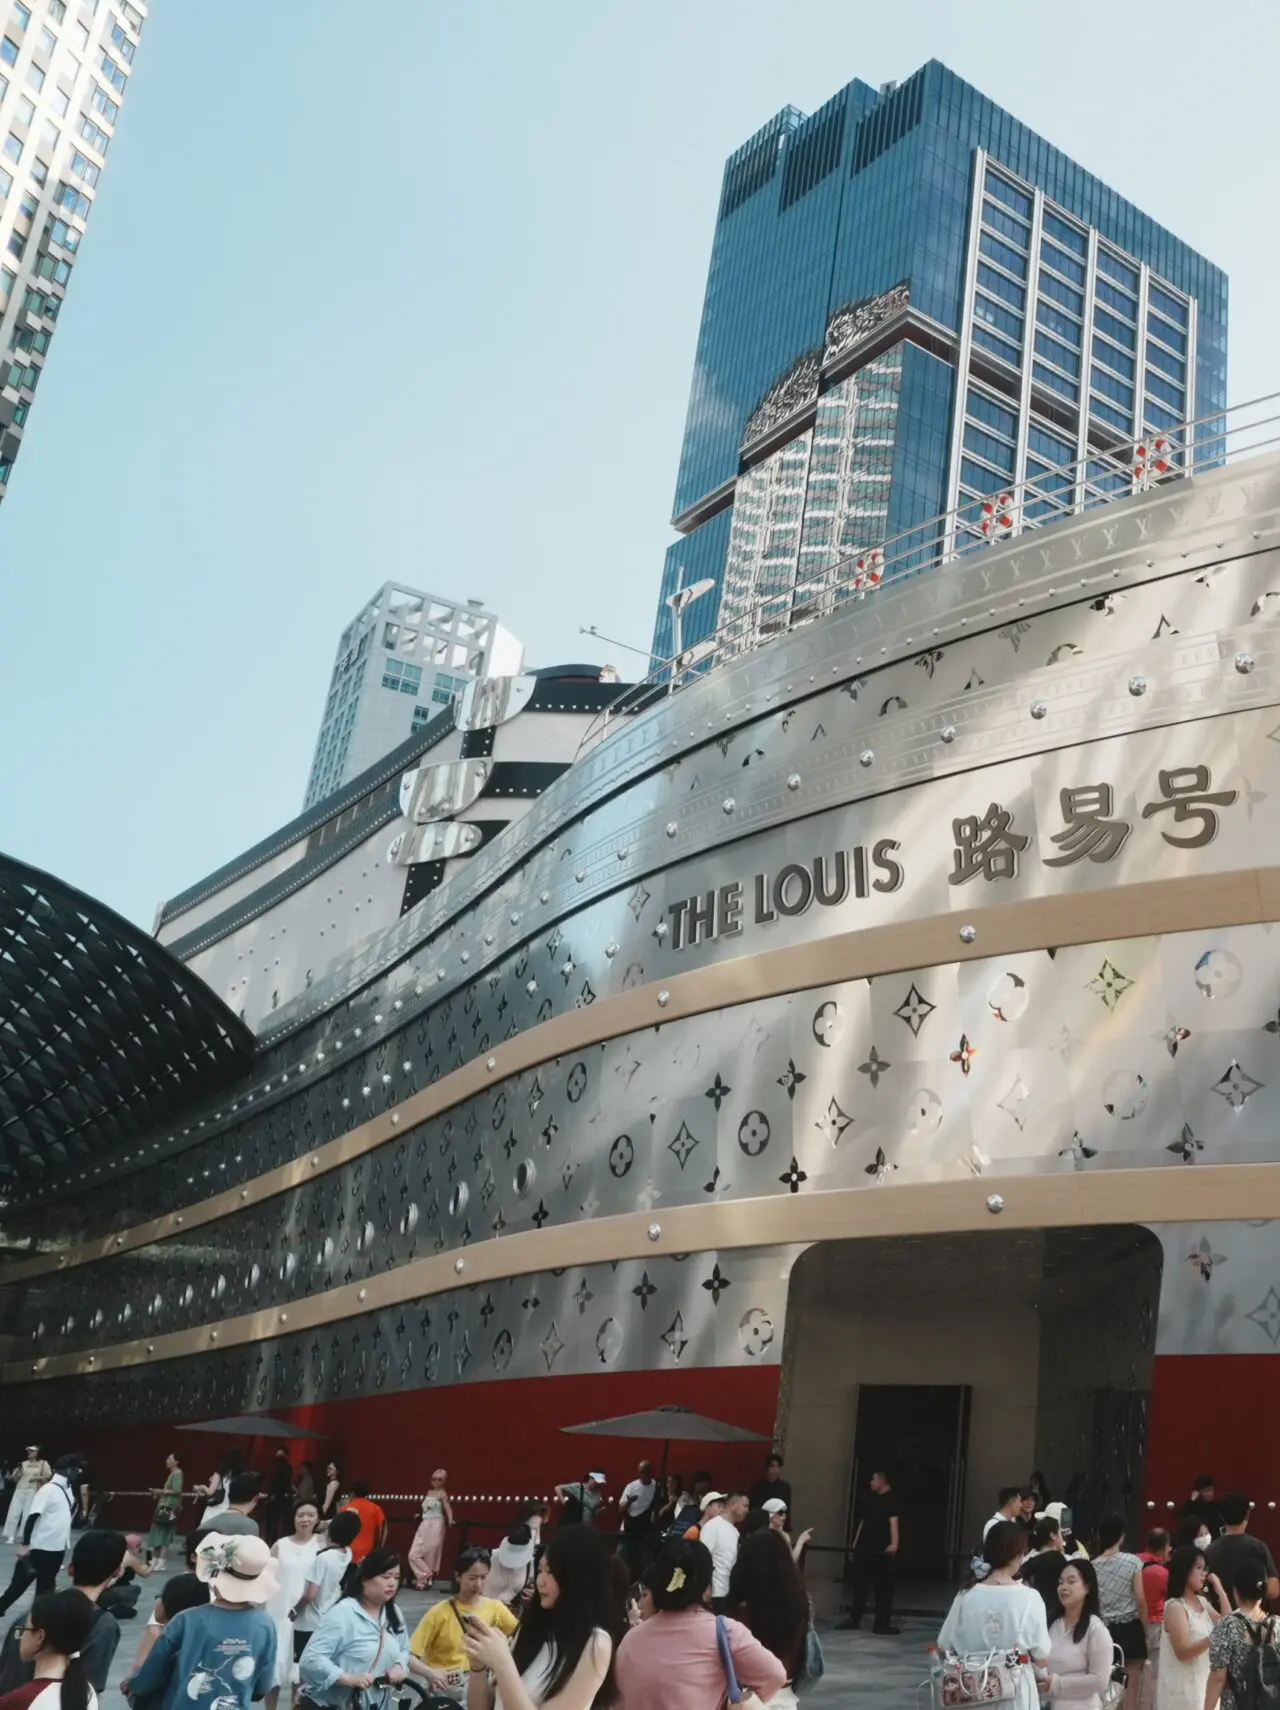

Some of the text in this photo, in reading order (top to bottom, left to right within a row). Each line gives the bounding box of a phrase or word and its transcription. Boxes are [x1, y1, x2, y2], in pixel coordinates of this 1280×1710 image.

[948, 764, 1238, 887] 路易号
[668, 839, 904, 950] THE LOUIS
